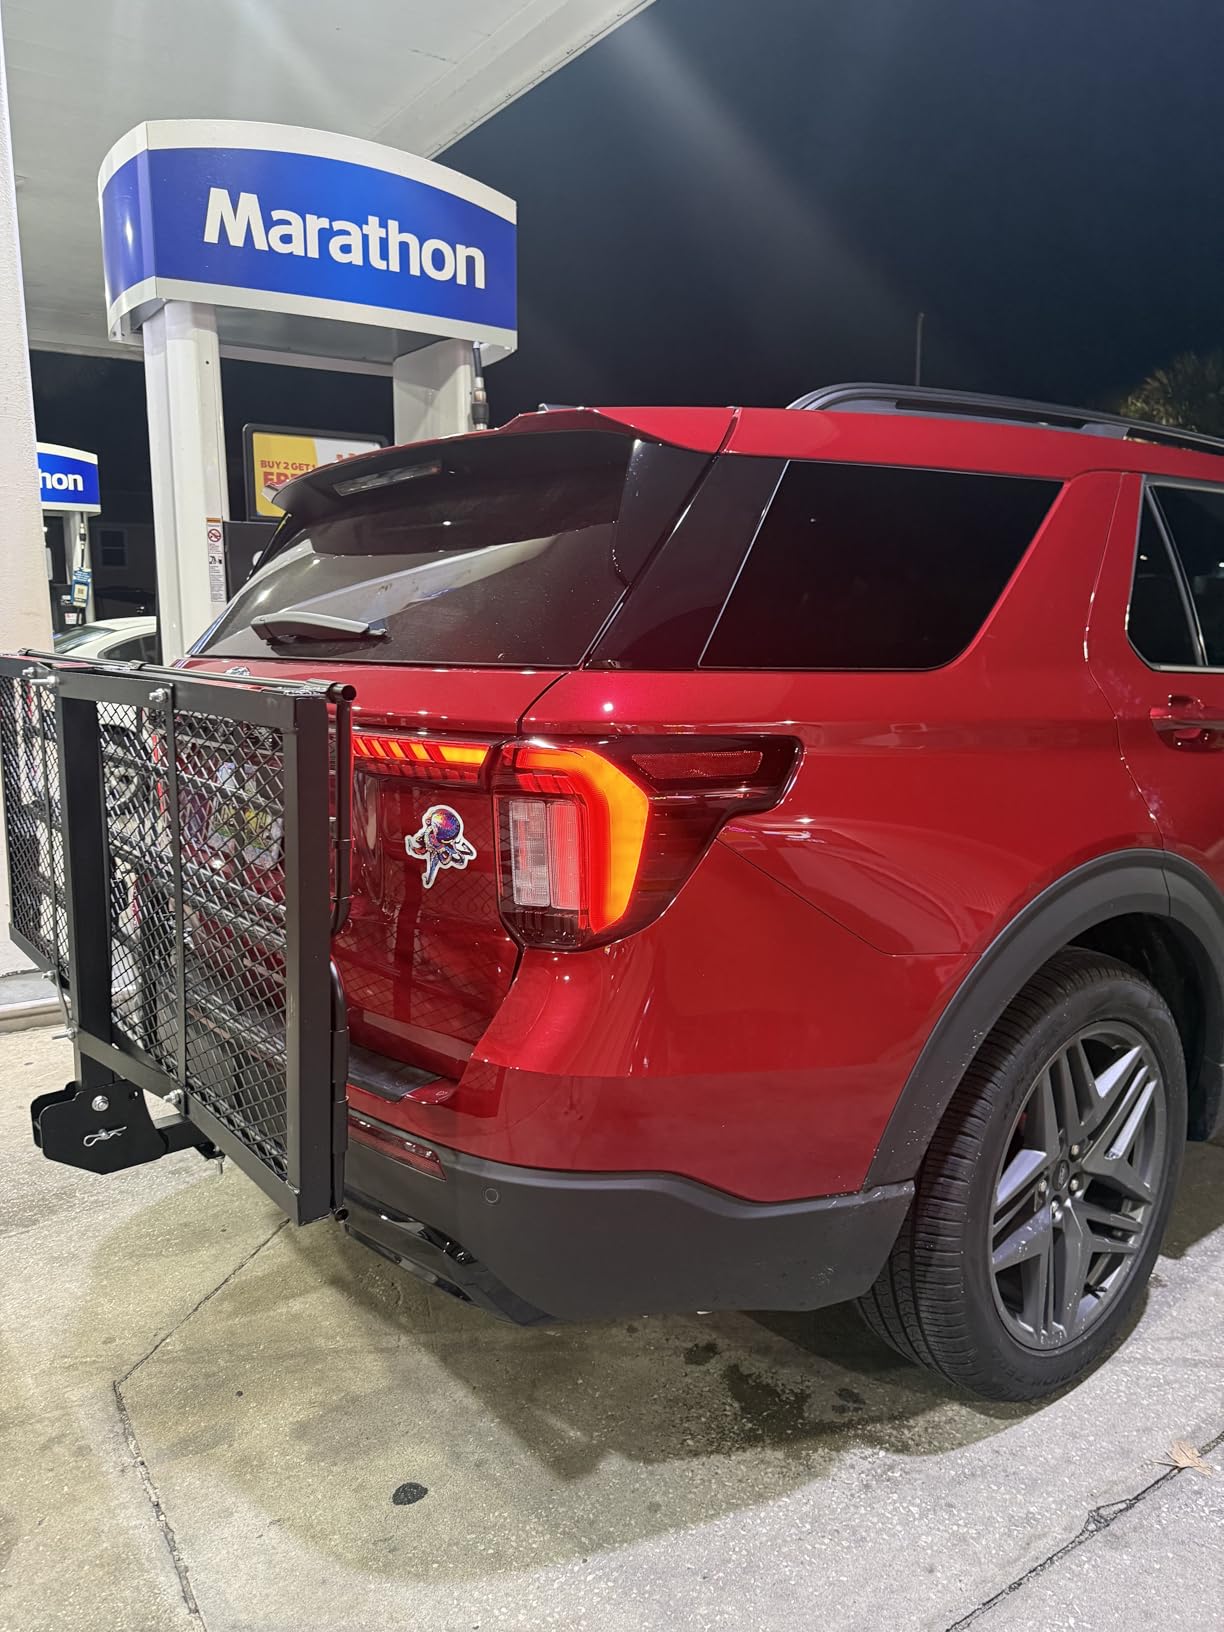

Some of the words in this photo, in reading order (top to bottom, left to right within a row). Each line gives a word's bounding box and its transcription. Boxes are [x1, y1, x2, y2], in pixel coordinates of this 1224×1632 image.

[203, 187, 486, 290] Marathon
[261, 460, 281, 469] BUY
[283, 462, 290, 470] 2
[291, 463, 310, 471] GET
[38, 468, 84, 491] hon
